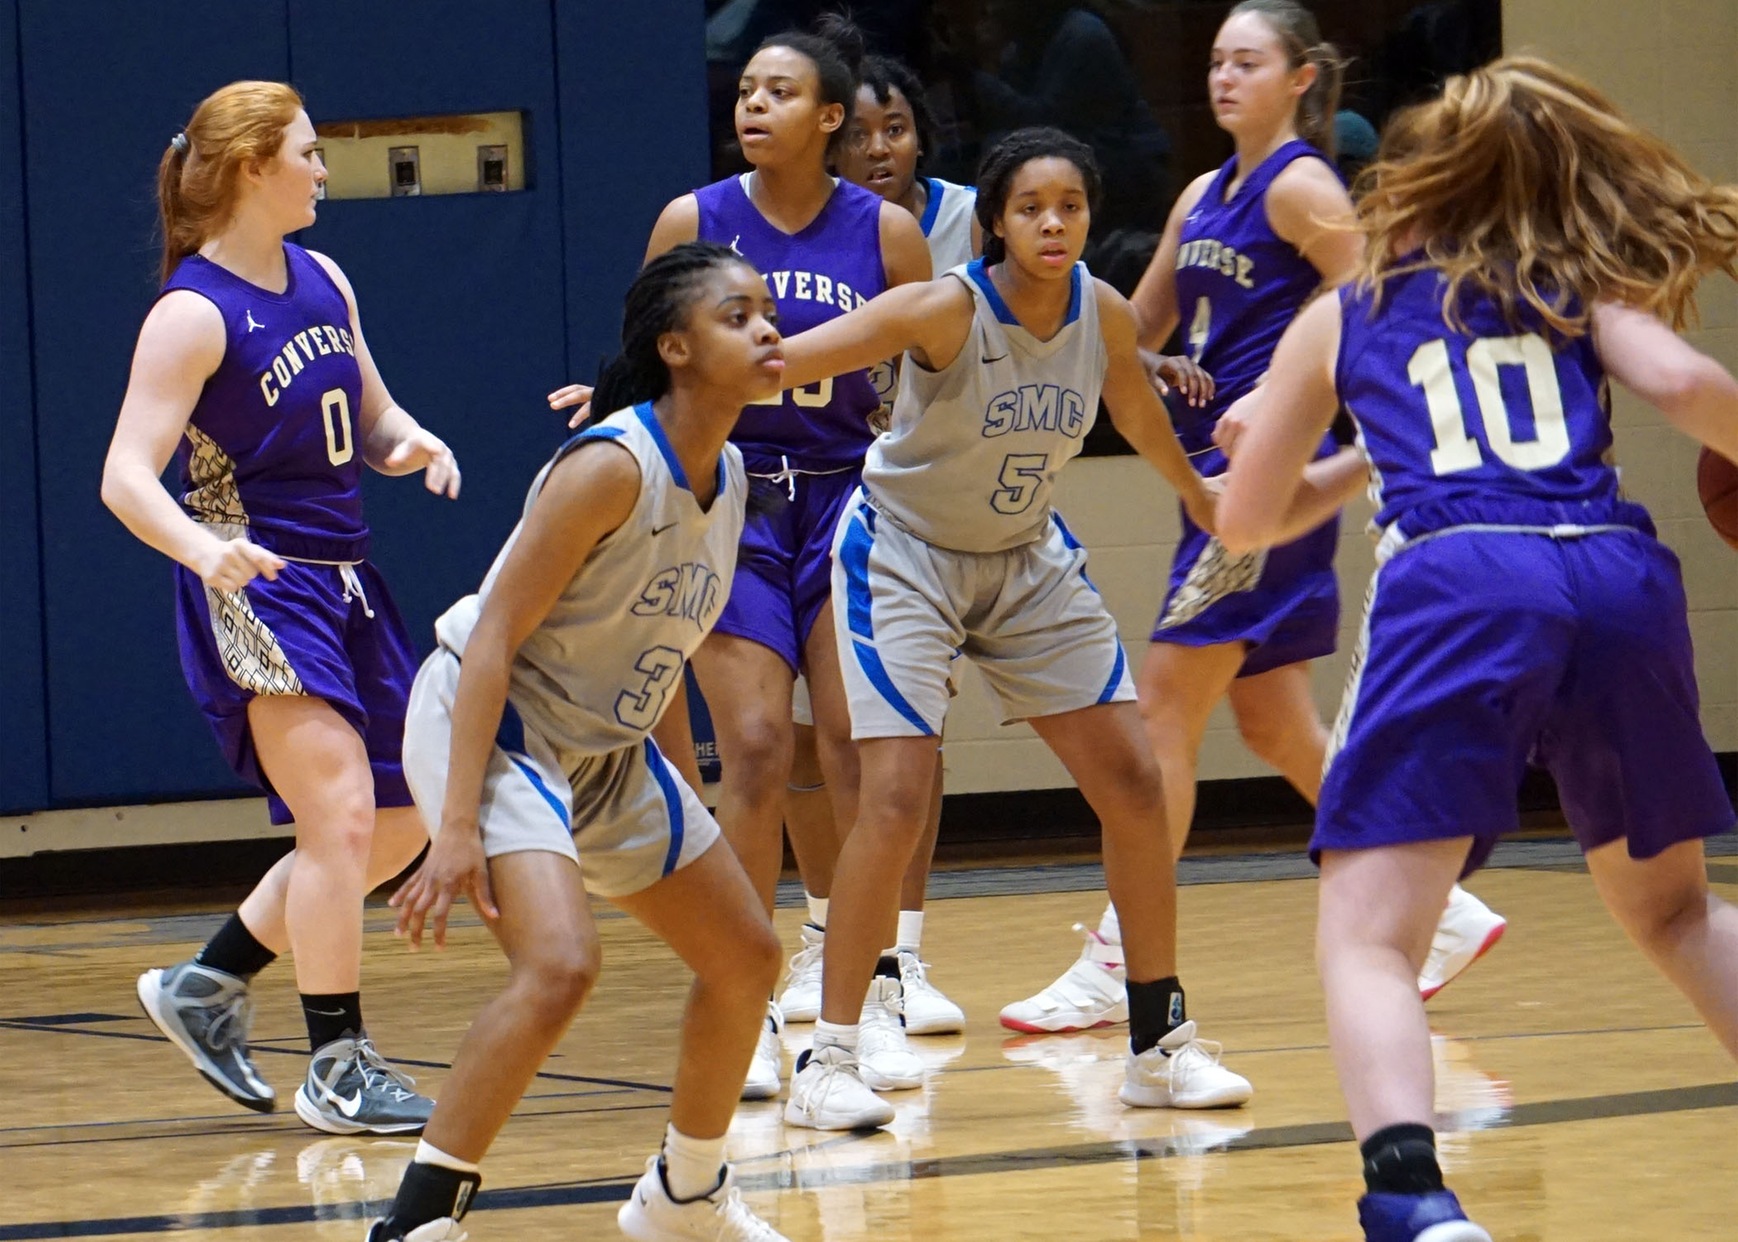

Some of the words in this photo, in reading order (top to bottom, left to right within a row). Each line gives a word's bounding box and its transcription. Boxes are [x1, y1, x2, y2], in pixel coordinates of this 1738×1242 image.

[761, 270, 868, 313] VERS
[260, 325, 355, 407] CONVERS
[321, 387, 354, 467] 0
[982, 384, 1085, 438] SMC
[1407, 332, 1571, 477] 10
[990, 453, 1048, 515] 5
[614, 645, 684, 731] 3
[695, 742, 719, 757] HE
